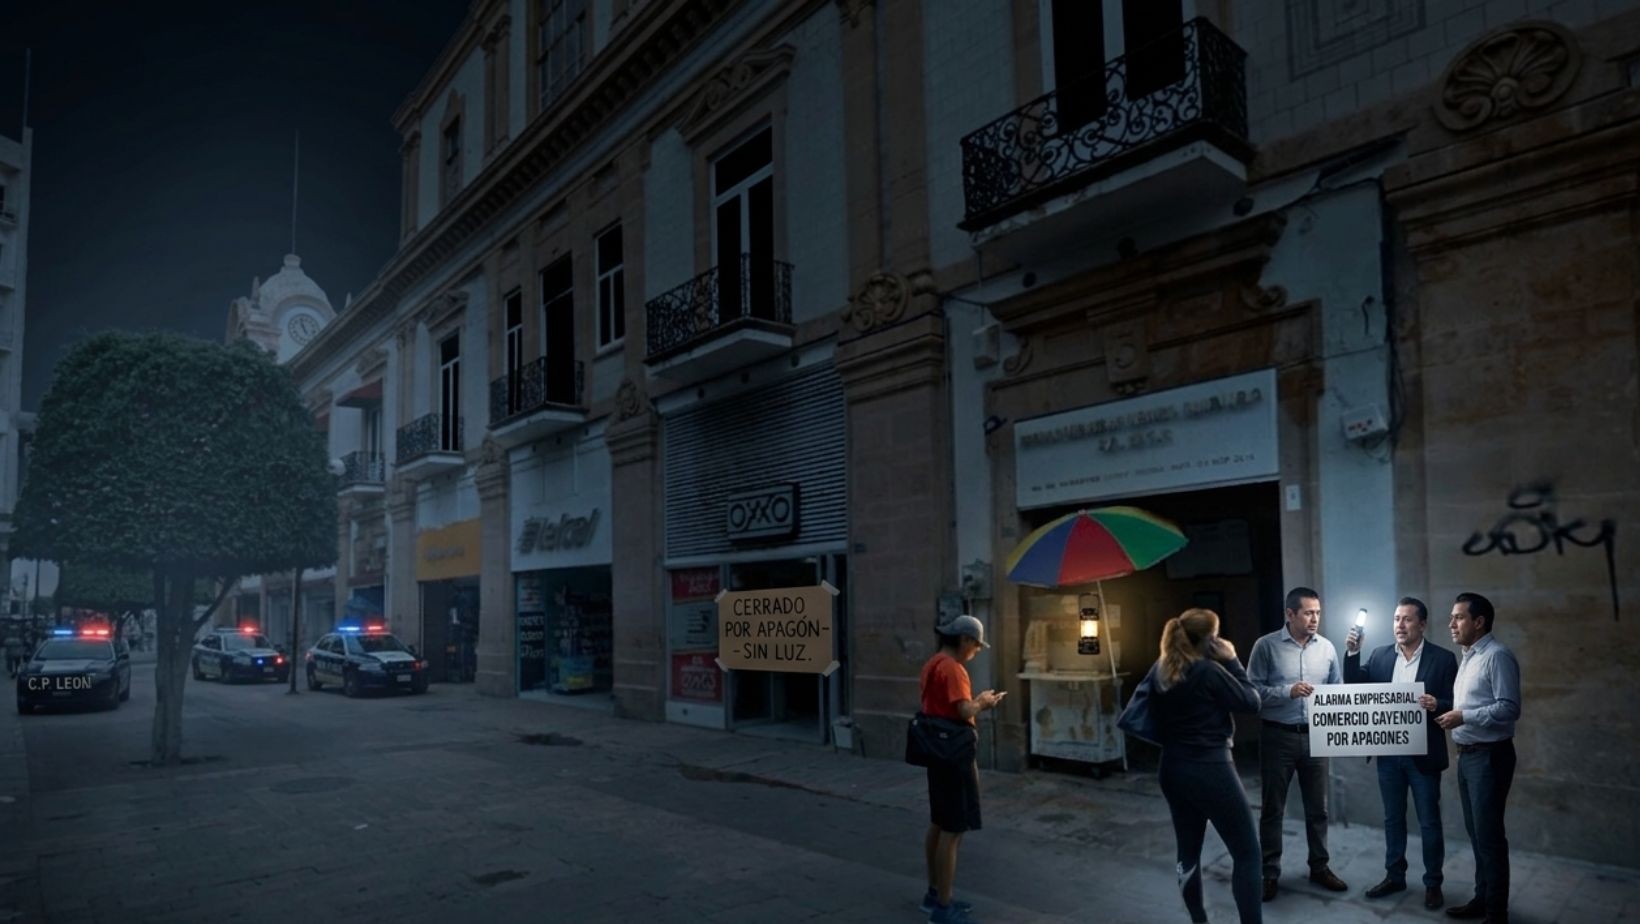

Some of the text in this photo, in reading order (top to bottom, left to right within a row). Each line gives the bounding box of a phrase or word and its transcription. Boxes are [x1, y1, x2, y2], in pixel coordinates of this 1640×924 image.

[733, 597, 805, 615] CERRADO
[725, 621, 751, 637] POR
[775, 644, 812, 661] LUZ.
[56, 676, 92, 690] LEON
[1314, 692, 1417, 706] ALARMA EMPRESARIAL
[1313, 710, 1422, 727] COMERCIO CAYENDO
[1327, 730, 1409, 746] POR APAGONES
